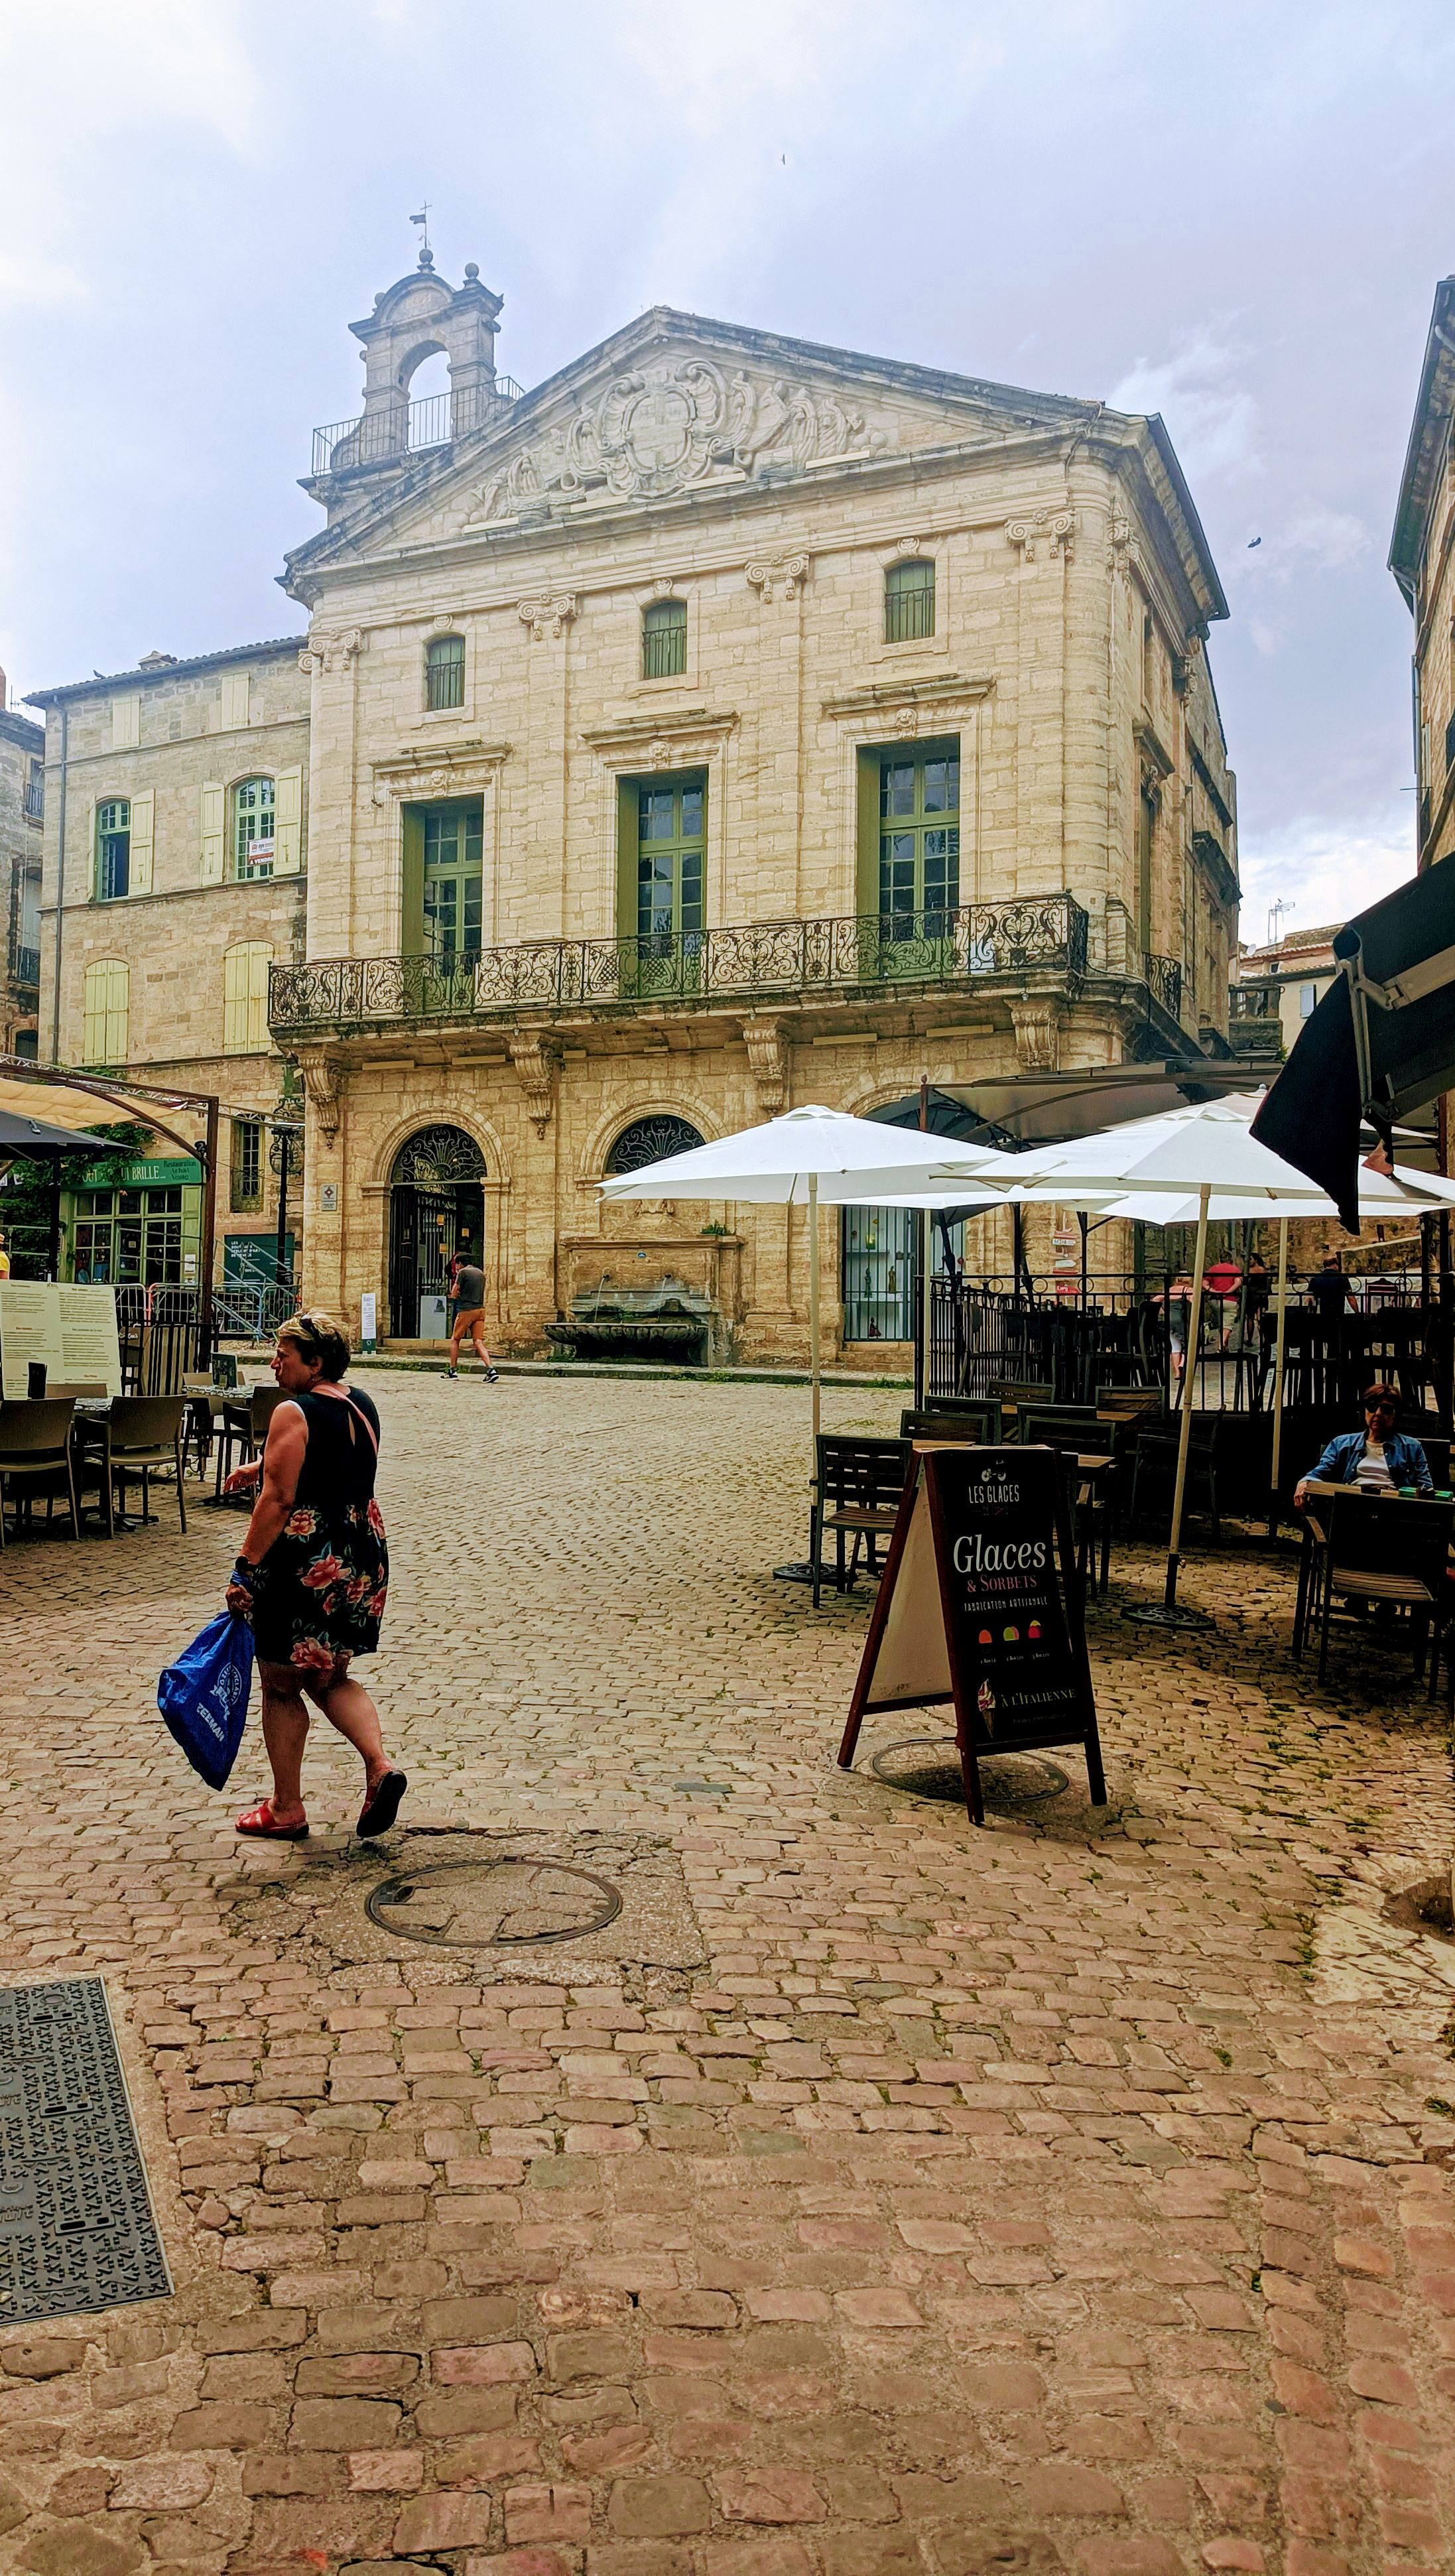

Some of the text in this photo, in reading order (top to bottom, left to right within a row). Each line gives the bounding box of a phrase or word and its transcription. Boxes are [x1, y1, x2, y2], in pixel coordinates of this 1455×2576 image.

[968, 1484, 1020, 1504] LES GLACES
[953, 1533, 1046, 1573] Glaces
[967, 1574, 1037, 1592] & SORBETS
[964, 1596, 1048, 1612] FABRICATION ARTISANALE
